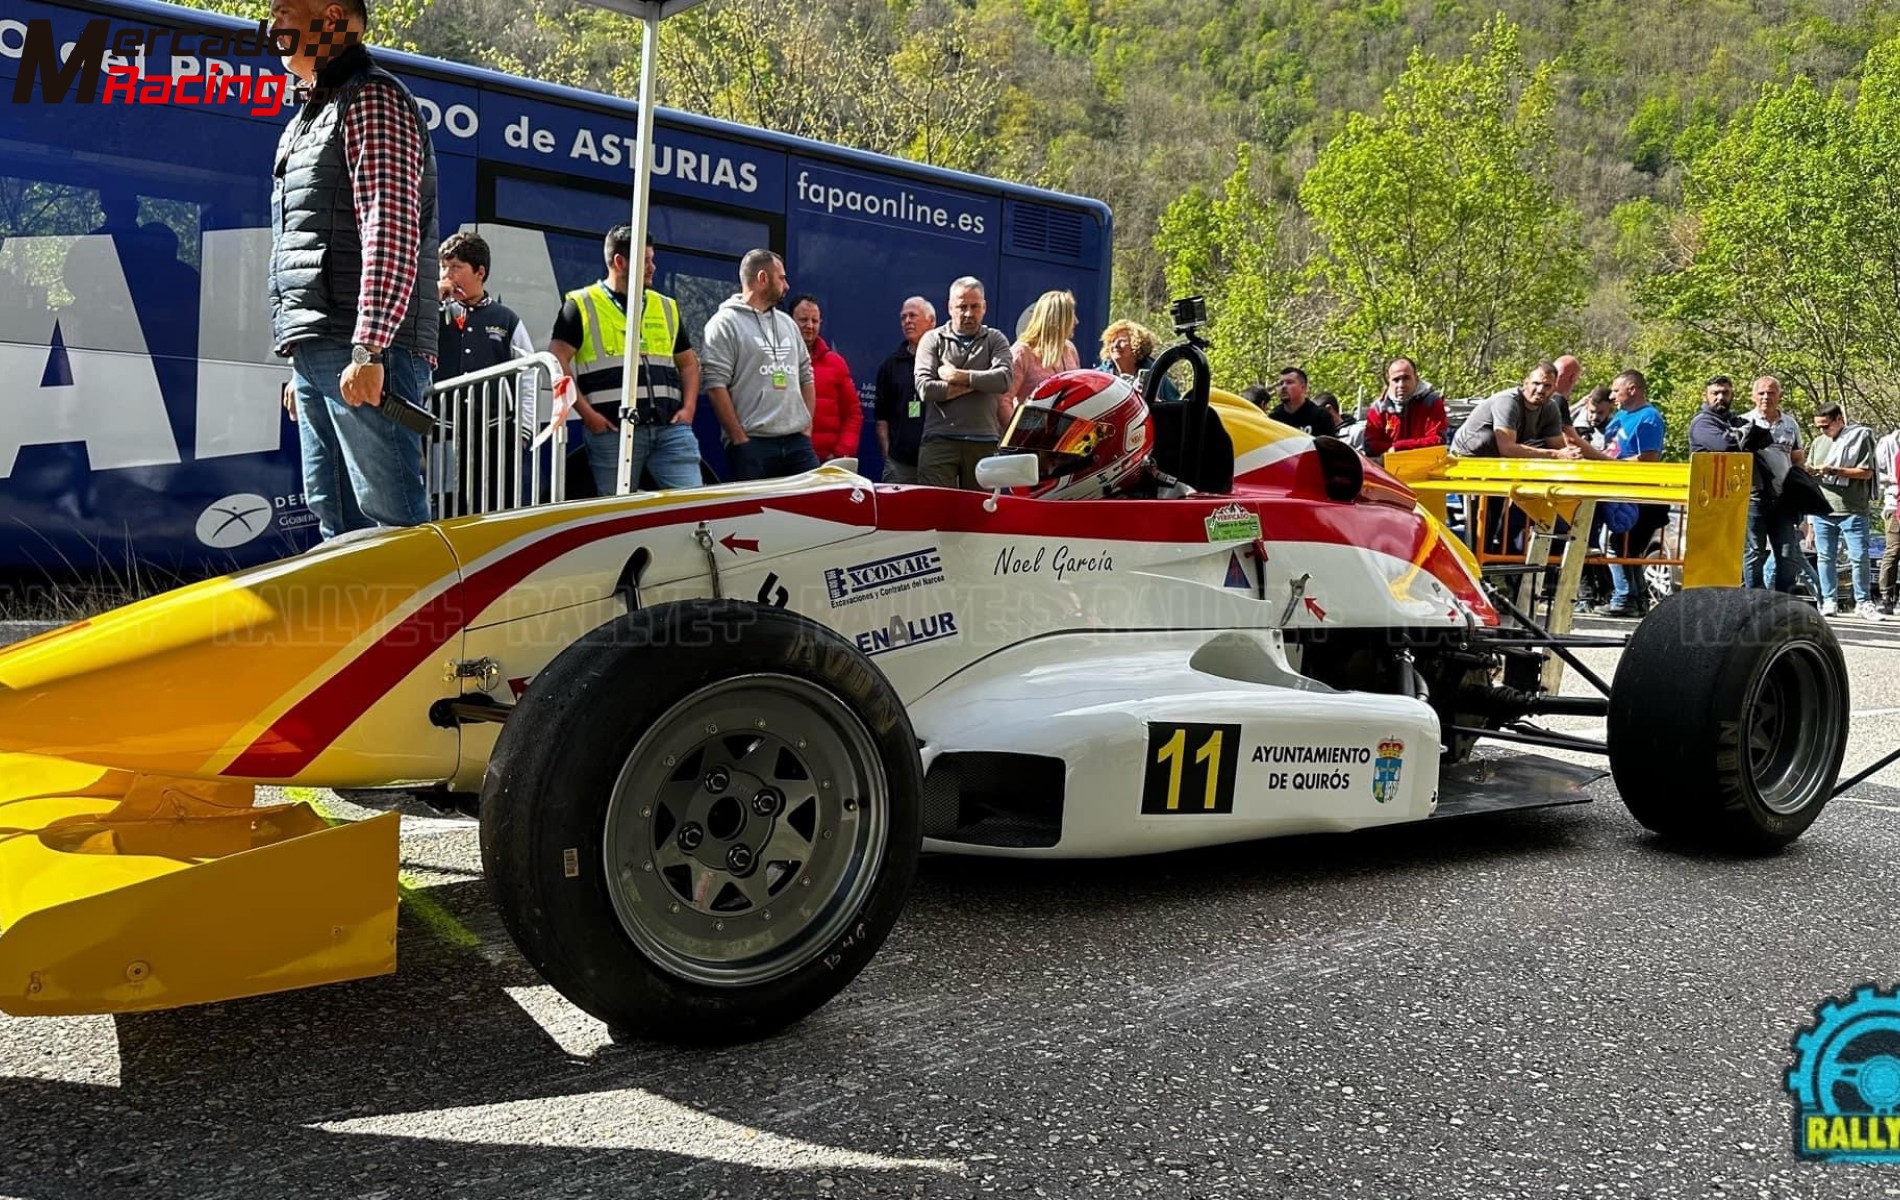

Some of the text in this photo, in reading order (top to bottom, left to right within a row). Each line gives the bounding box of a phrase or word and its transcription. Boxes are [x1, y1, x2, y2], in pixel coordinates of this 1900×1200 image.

[504, 116, 555, 153] de
[570, 129, 758, 193] ASTURIAS
[797, 171, 985, 234] fapaonline.es
[993, 545, 1113, 581] Noel García
[830, 591, 874, 608] Excavaciones
[880, 583, 911, 596] Contratas
[912, 578, 922, 588] del
[923, 574, 945, 586] Narcea
[855, 612, 959, 653] ENALUR
[1157, 729, 1224, 810] 11
[1251, 745, 1371, 764] AYUNTAMIENTO
[1268, 767, 1350, 790] DE QUIRÓS
